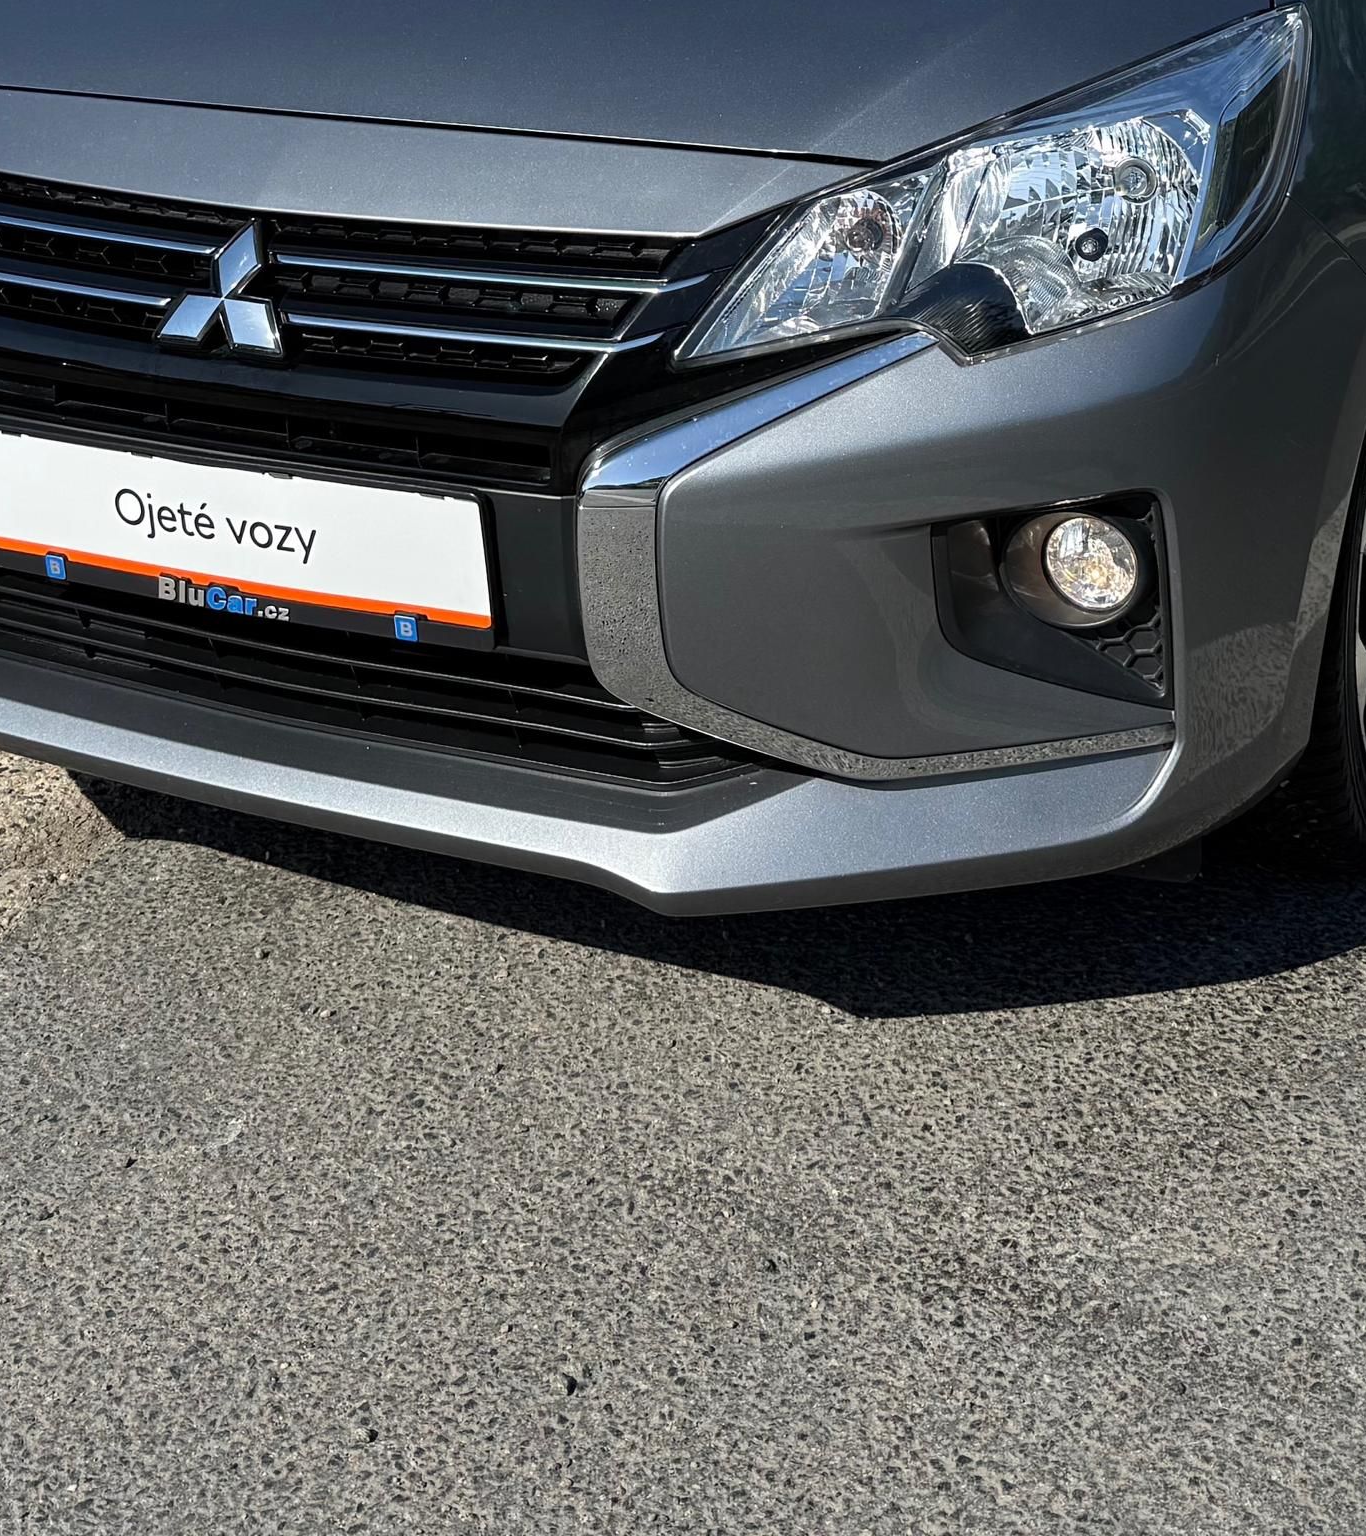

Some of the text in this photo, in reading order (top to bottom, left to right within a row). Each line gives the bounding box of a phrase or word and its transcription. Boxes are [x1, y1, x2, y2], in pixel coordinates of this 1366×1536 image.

[114, 488, 317, 565] Ojeté vozy
[50, 558, 62, 575] B
[157, 576, 291, 622] BluCar.cz
[400, 621, 414, 637] B
